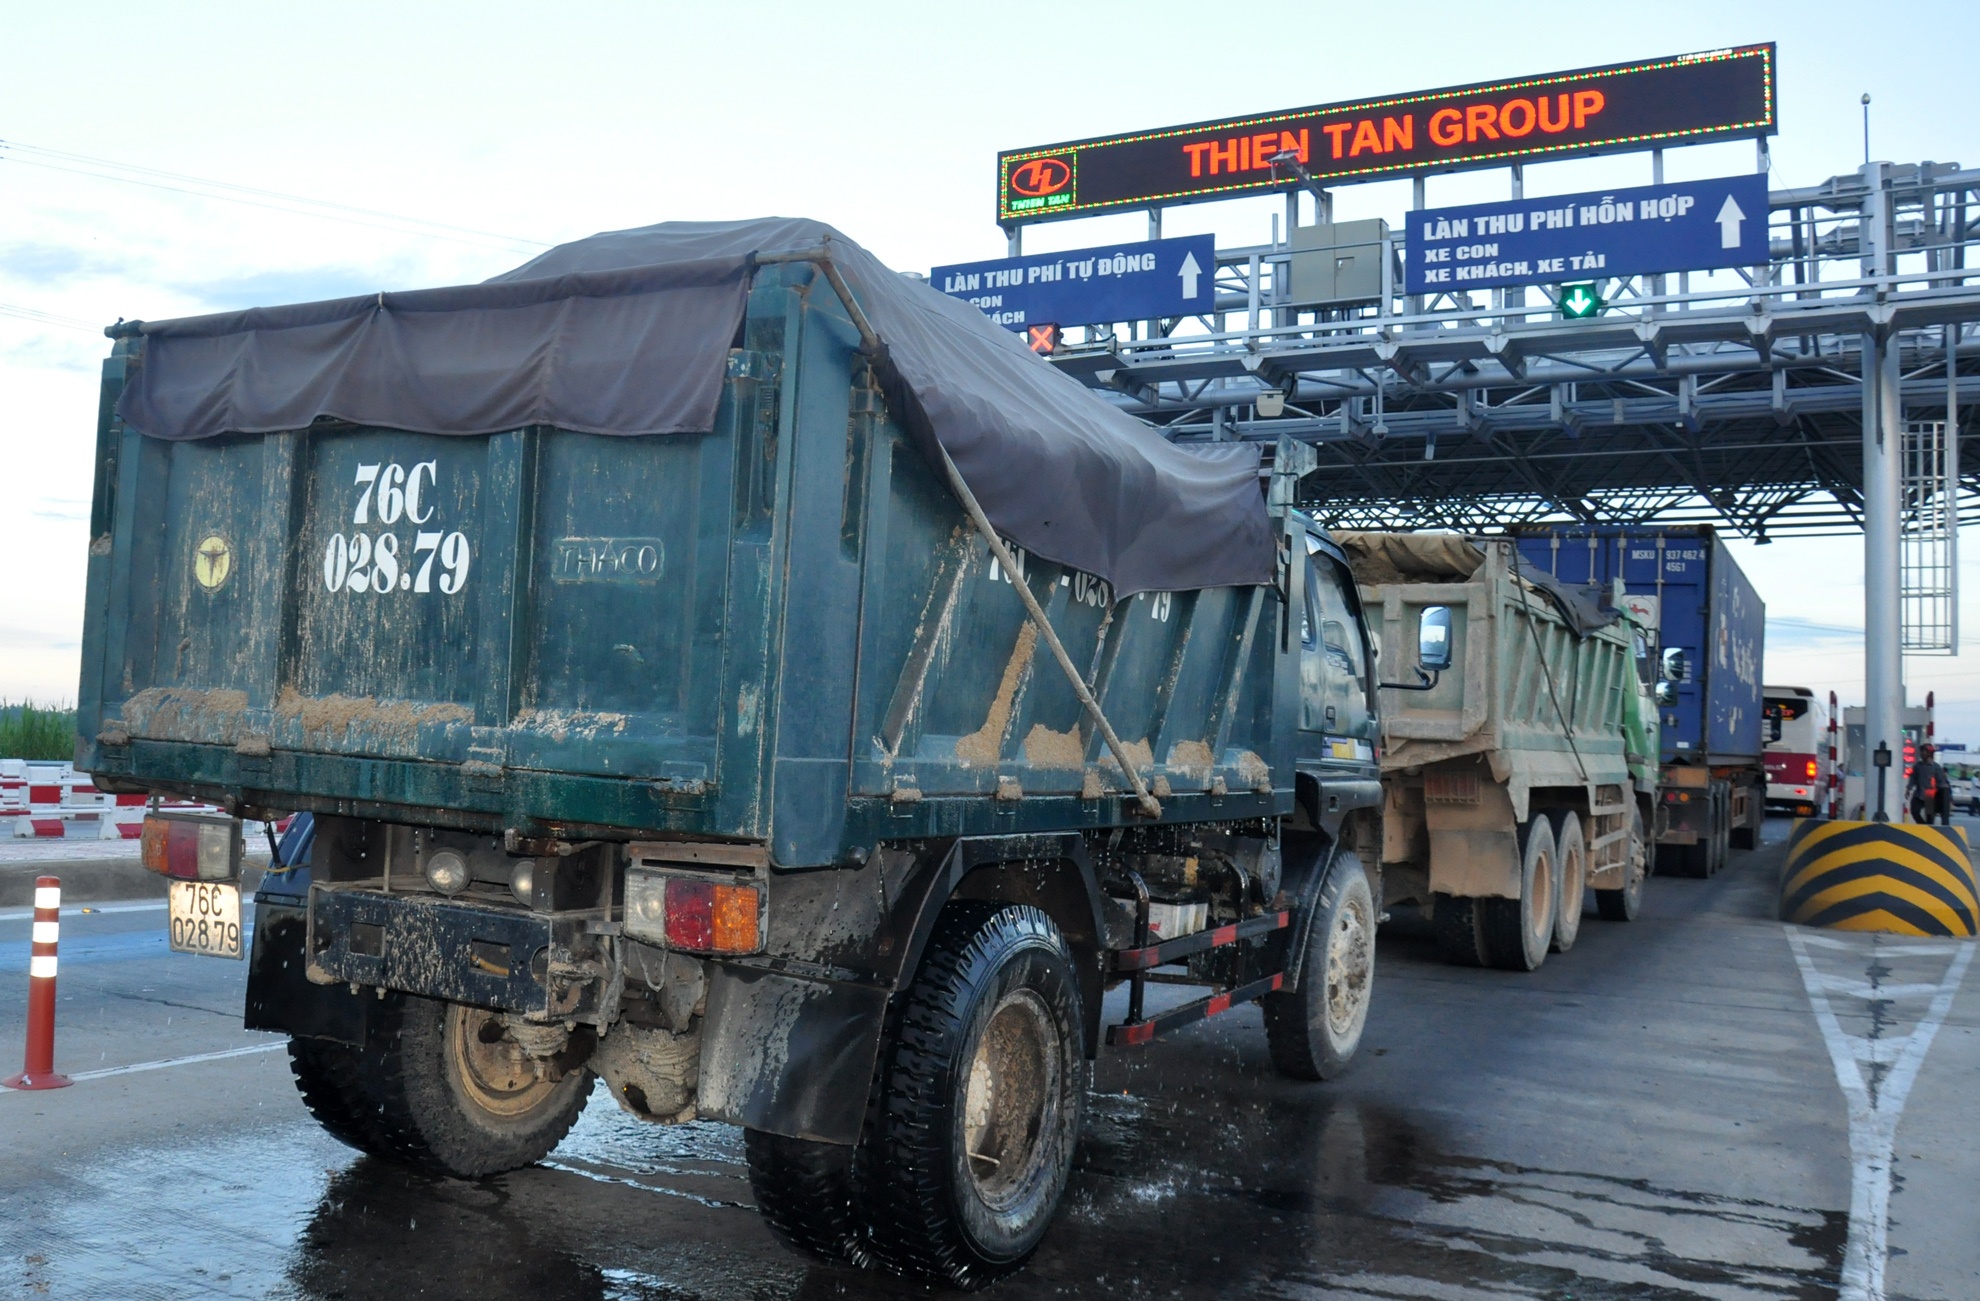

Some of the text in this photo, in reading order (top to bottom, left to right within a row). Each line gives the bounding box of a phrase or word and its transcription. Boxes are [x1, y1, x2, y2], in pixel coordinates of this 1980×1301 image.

[1183, 91, 1605, 177] THIEN TAN GROUP
[1424, 194, 1695, 241] LÀN THU PHÍ HỖN HỢP
[1424, 243, 1498, 263] XE CON
[1424, 251, 1605, 283] XE KHÁCH, XE TẢI
[945, 252, 1156, 293] LÀN THU PHÍ TỰ ĐỘNG
[352, 459, 437, 525] 76C
[323, 530, 470, 595] 028.79
[558, 541, 658, 575] THACO
[1632, 550, 1655, 560] MSKU
[185, 883, 223, 917] 76C
[172, 916, 239, 954] 028.79
